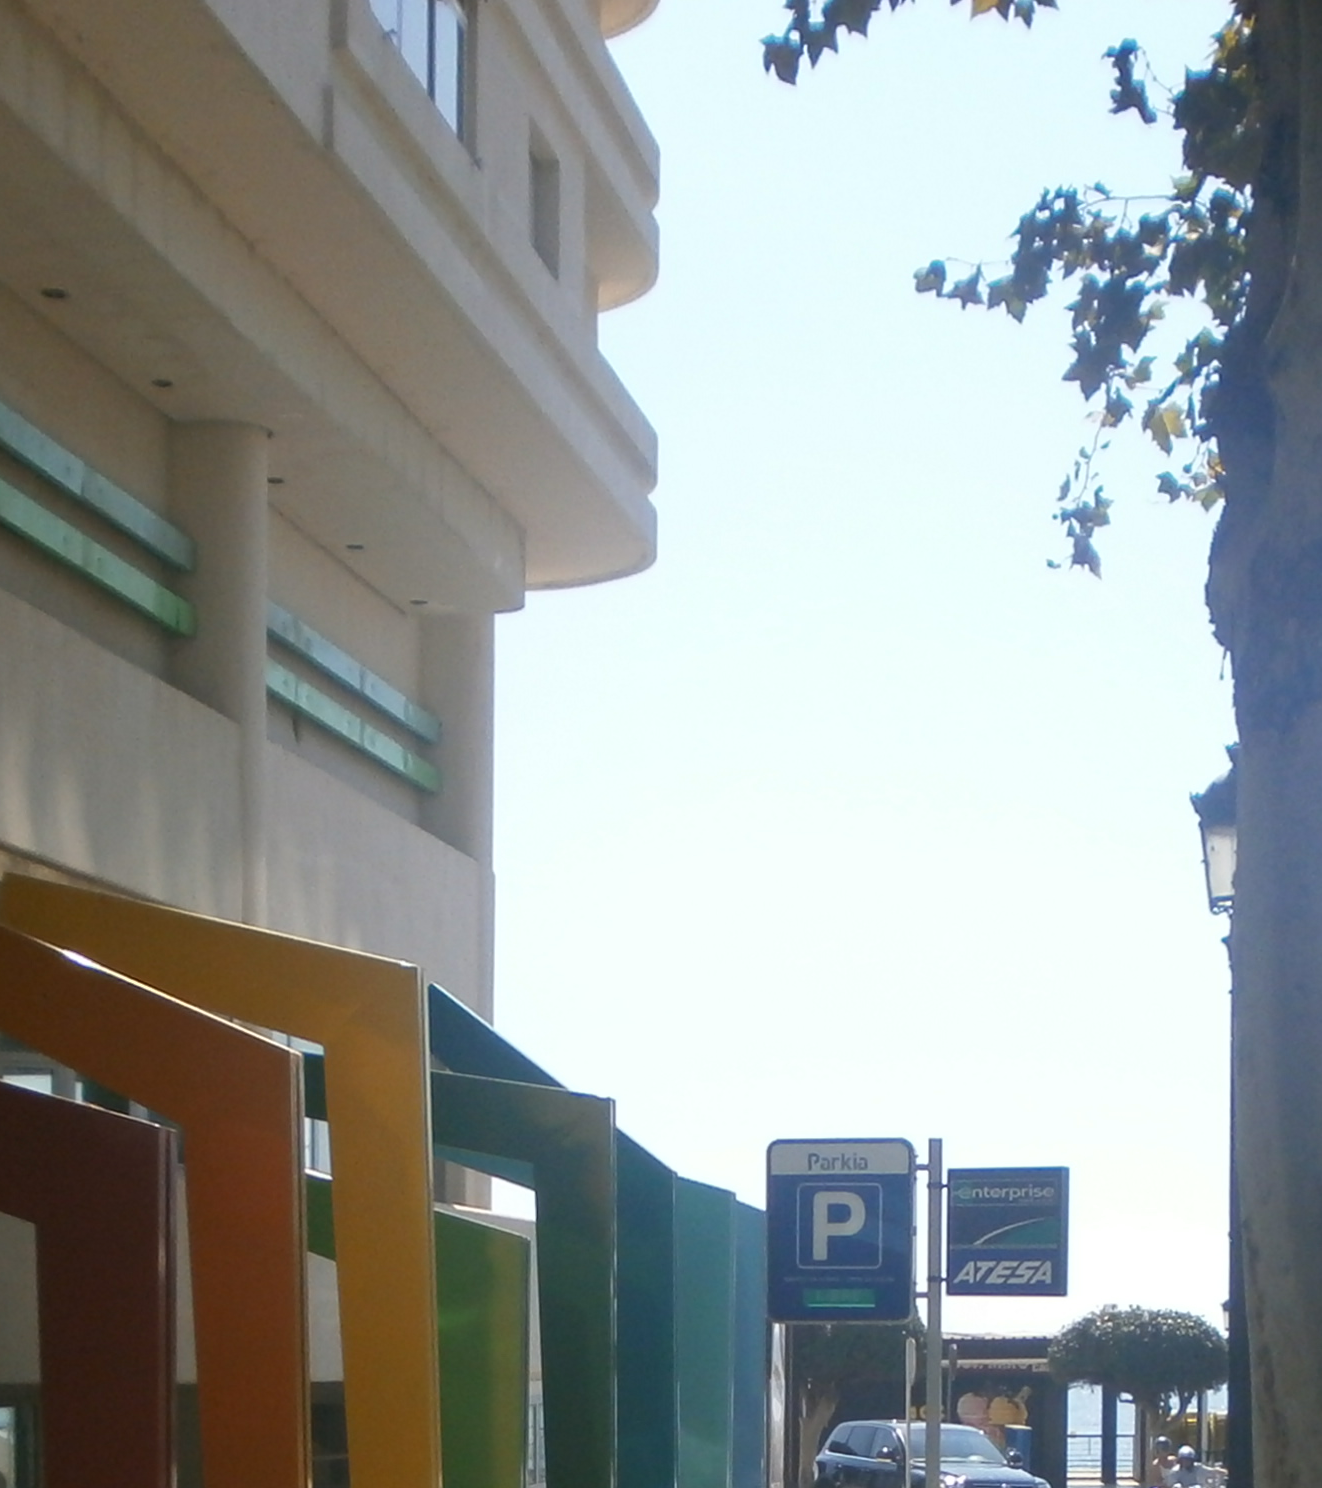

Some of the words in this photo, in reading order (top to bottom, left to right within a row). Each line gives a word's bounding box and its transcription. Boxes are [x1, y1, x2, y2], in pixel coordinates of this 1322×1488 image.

[807, 1152, 869, 1171] Parkia
[956, 1183, 1055, 1201] enterprise
[812, 1190, 866, 1262] P
[952, 1260, 1052, 1285] ATESA
